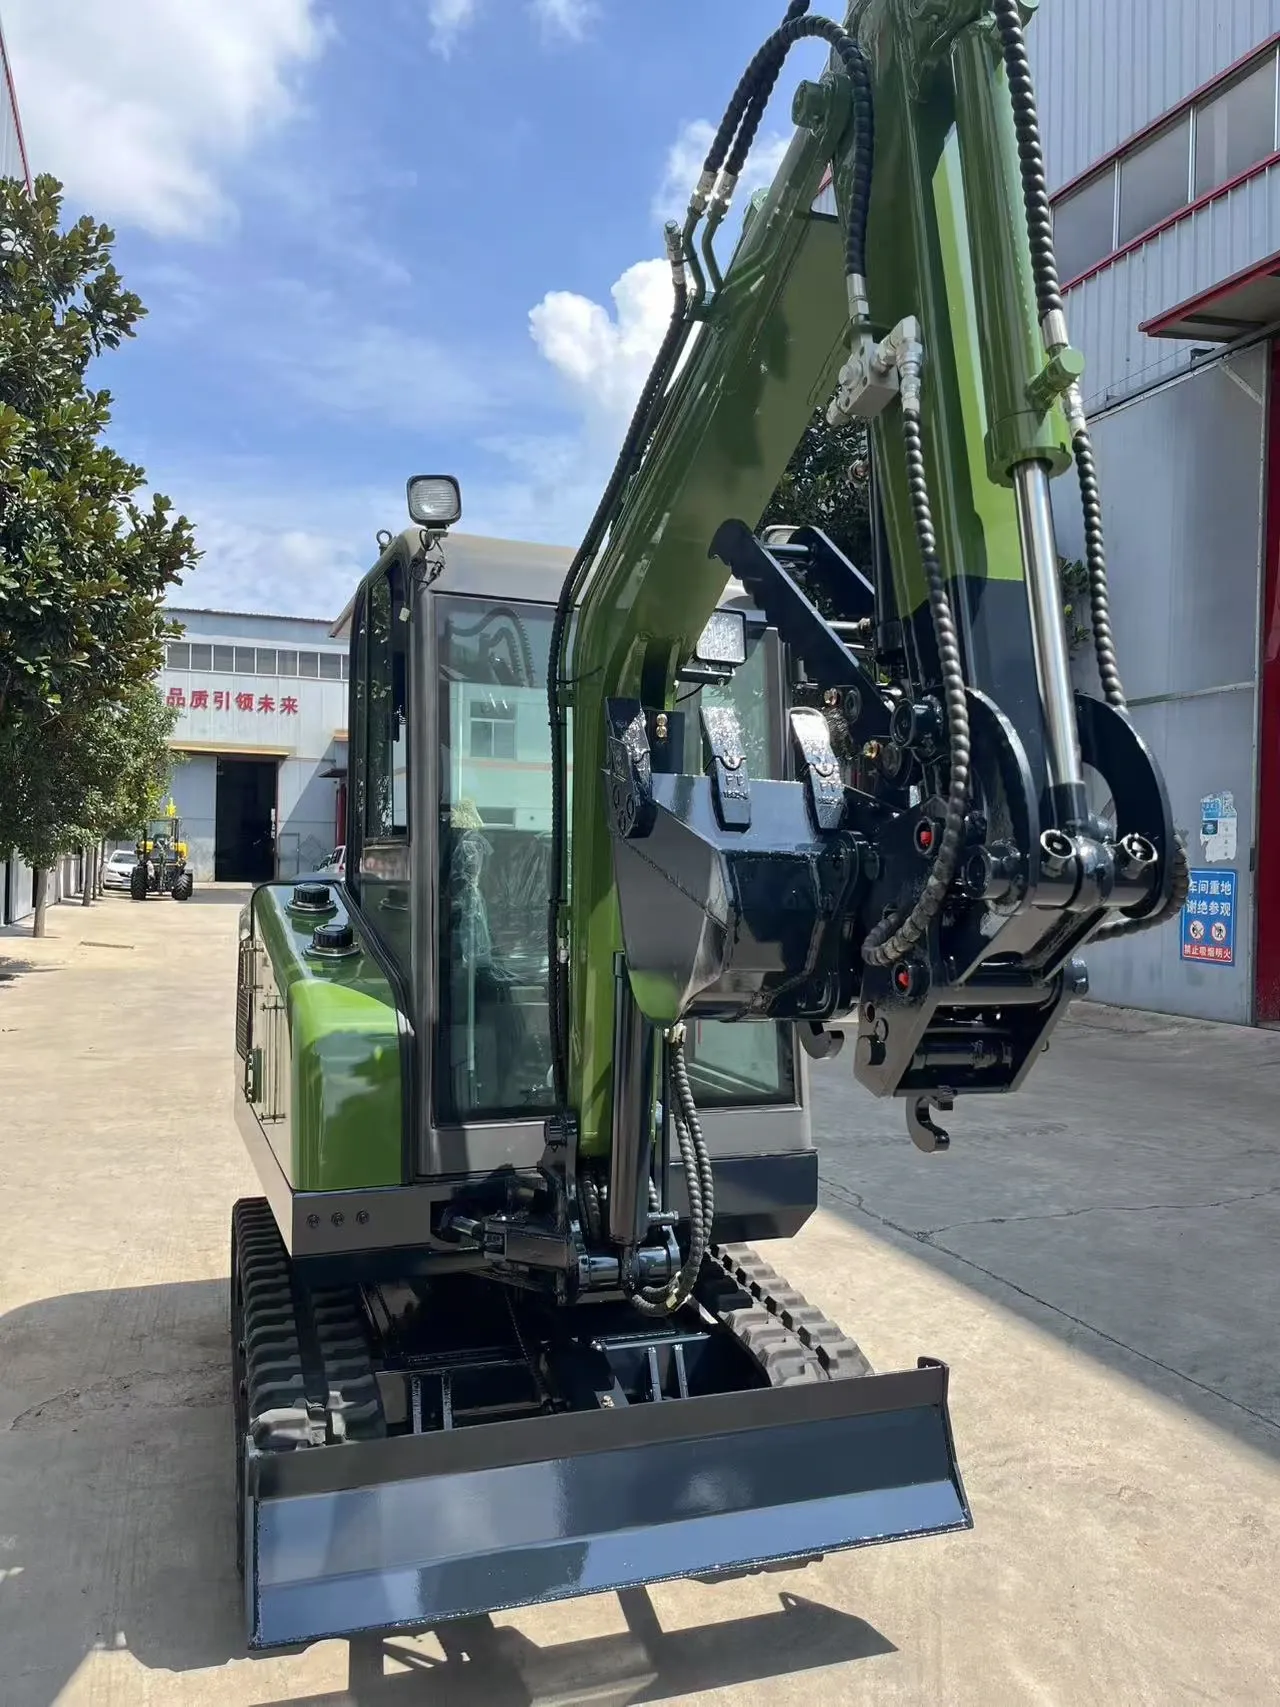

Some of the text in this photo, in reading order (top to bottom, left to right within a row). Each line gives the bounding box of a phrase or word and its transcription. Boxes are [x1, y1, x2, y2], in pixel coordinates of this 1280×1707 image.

[166, 687, 298, 714] 品质引领未来
[1189, 879, 1231, 895] 车间重地
[1187, 899, 1231, 916] 谢绝参观
[1184, 944, 1231, 959] 禁止吸烟明火
